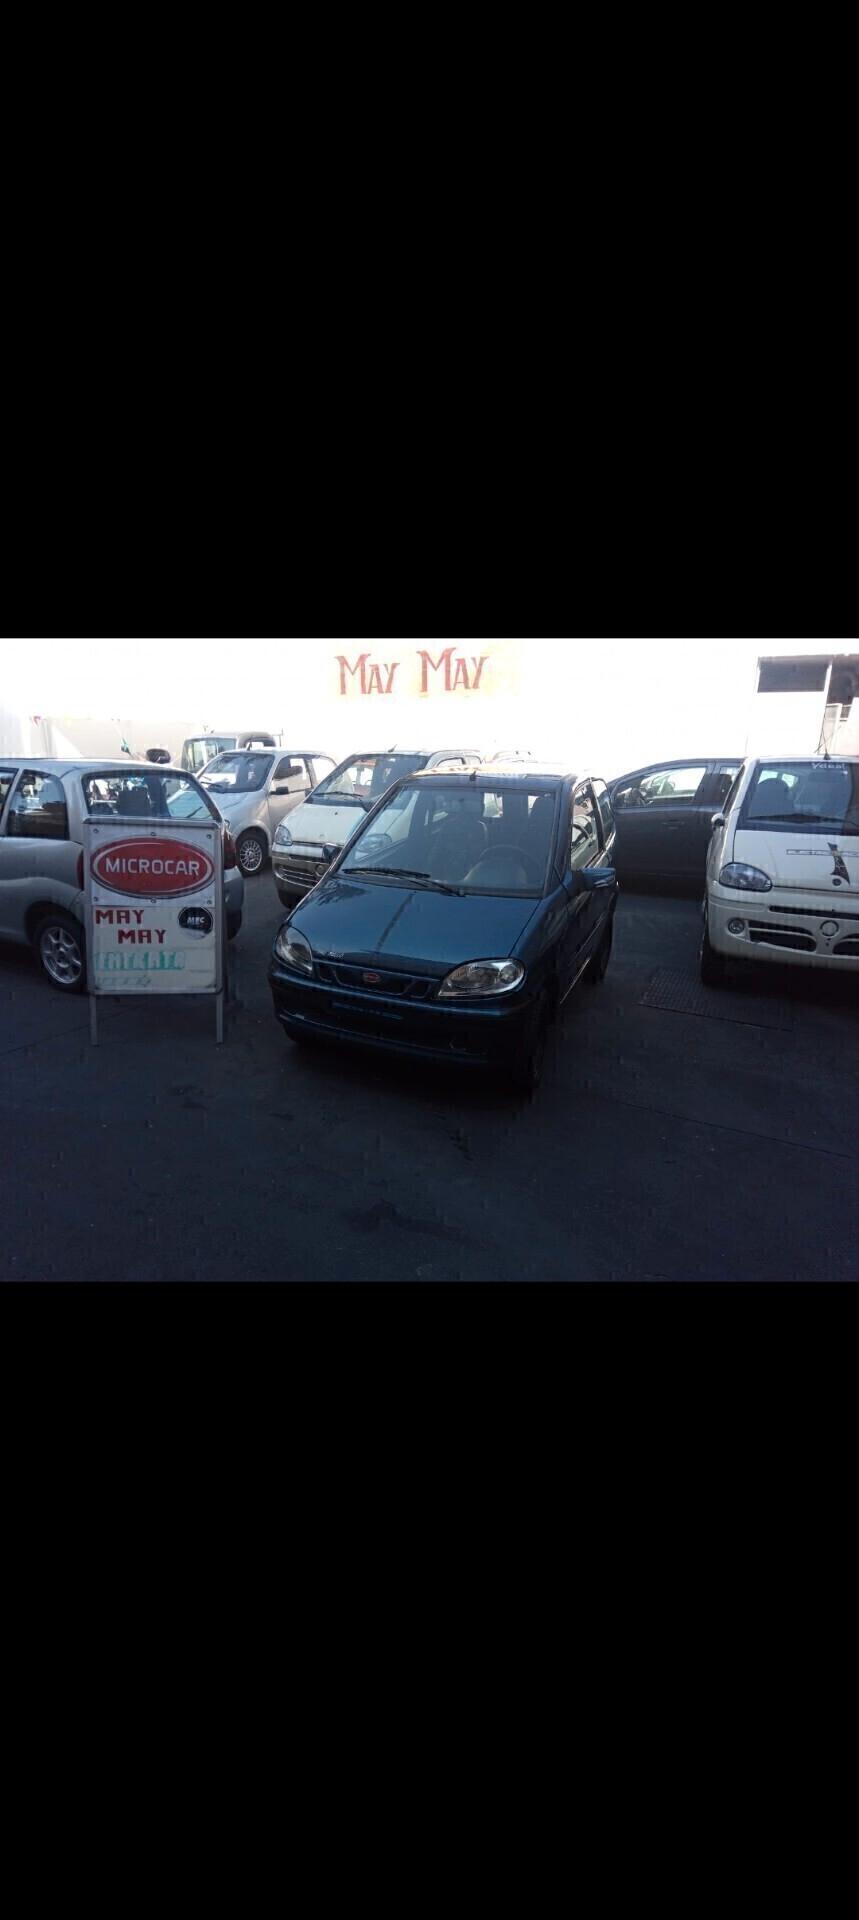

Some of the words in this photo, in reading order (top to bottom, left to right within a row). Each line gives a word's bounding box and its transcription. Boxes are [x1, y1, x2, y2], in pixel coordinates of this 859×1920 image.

[105, 857, 200, 875] MICROCAR
[95, 909, 145, 924] MAY
[117, 929, 167, 944] MAY
